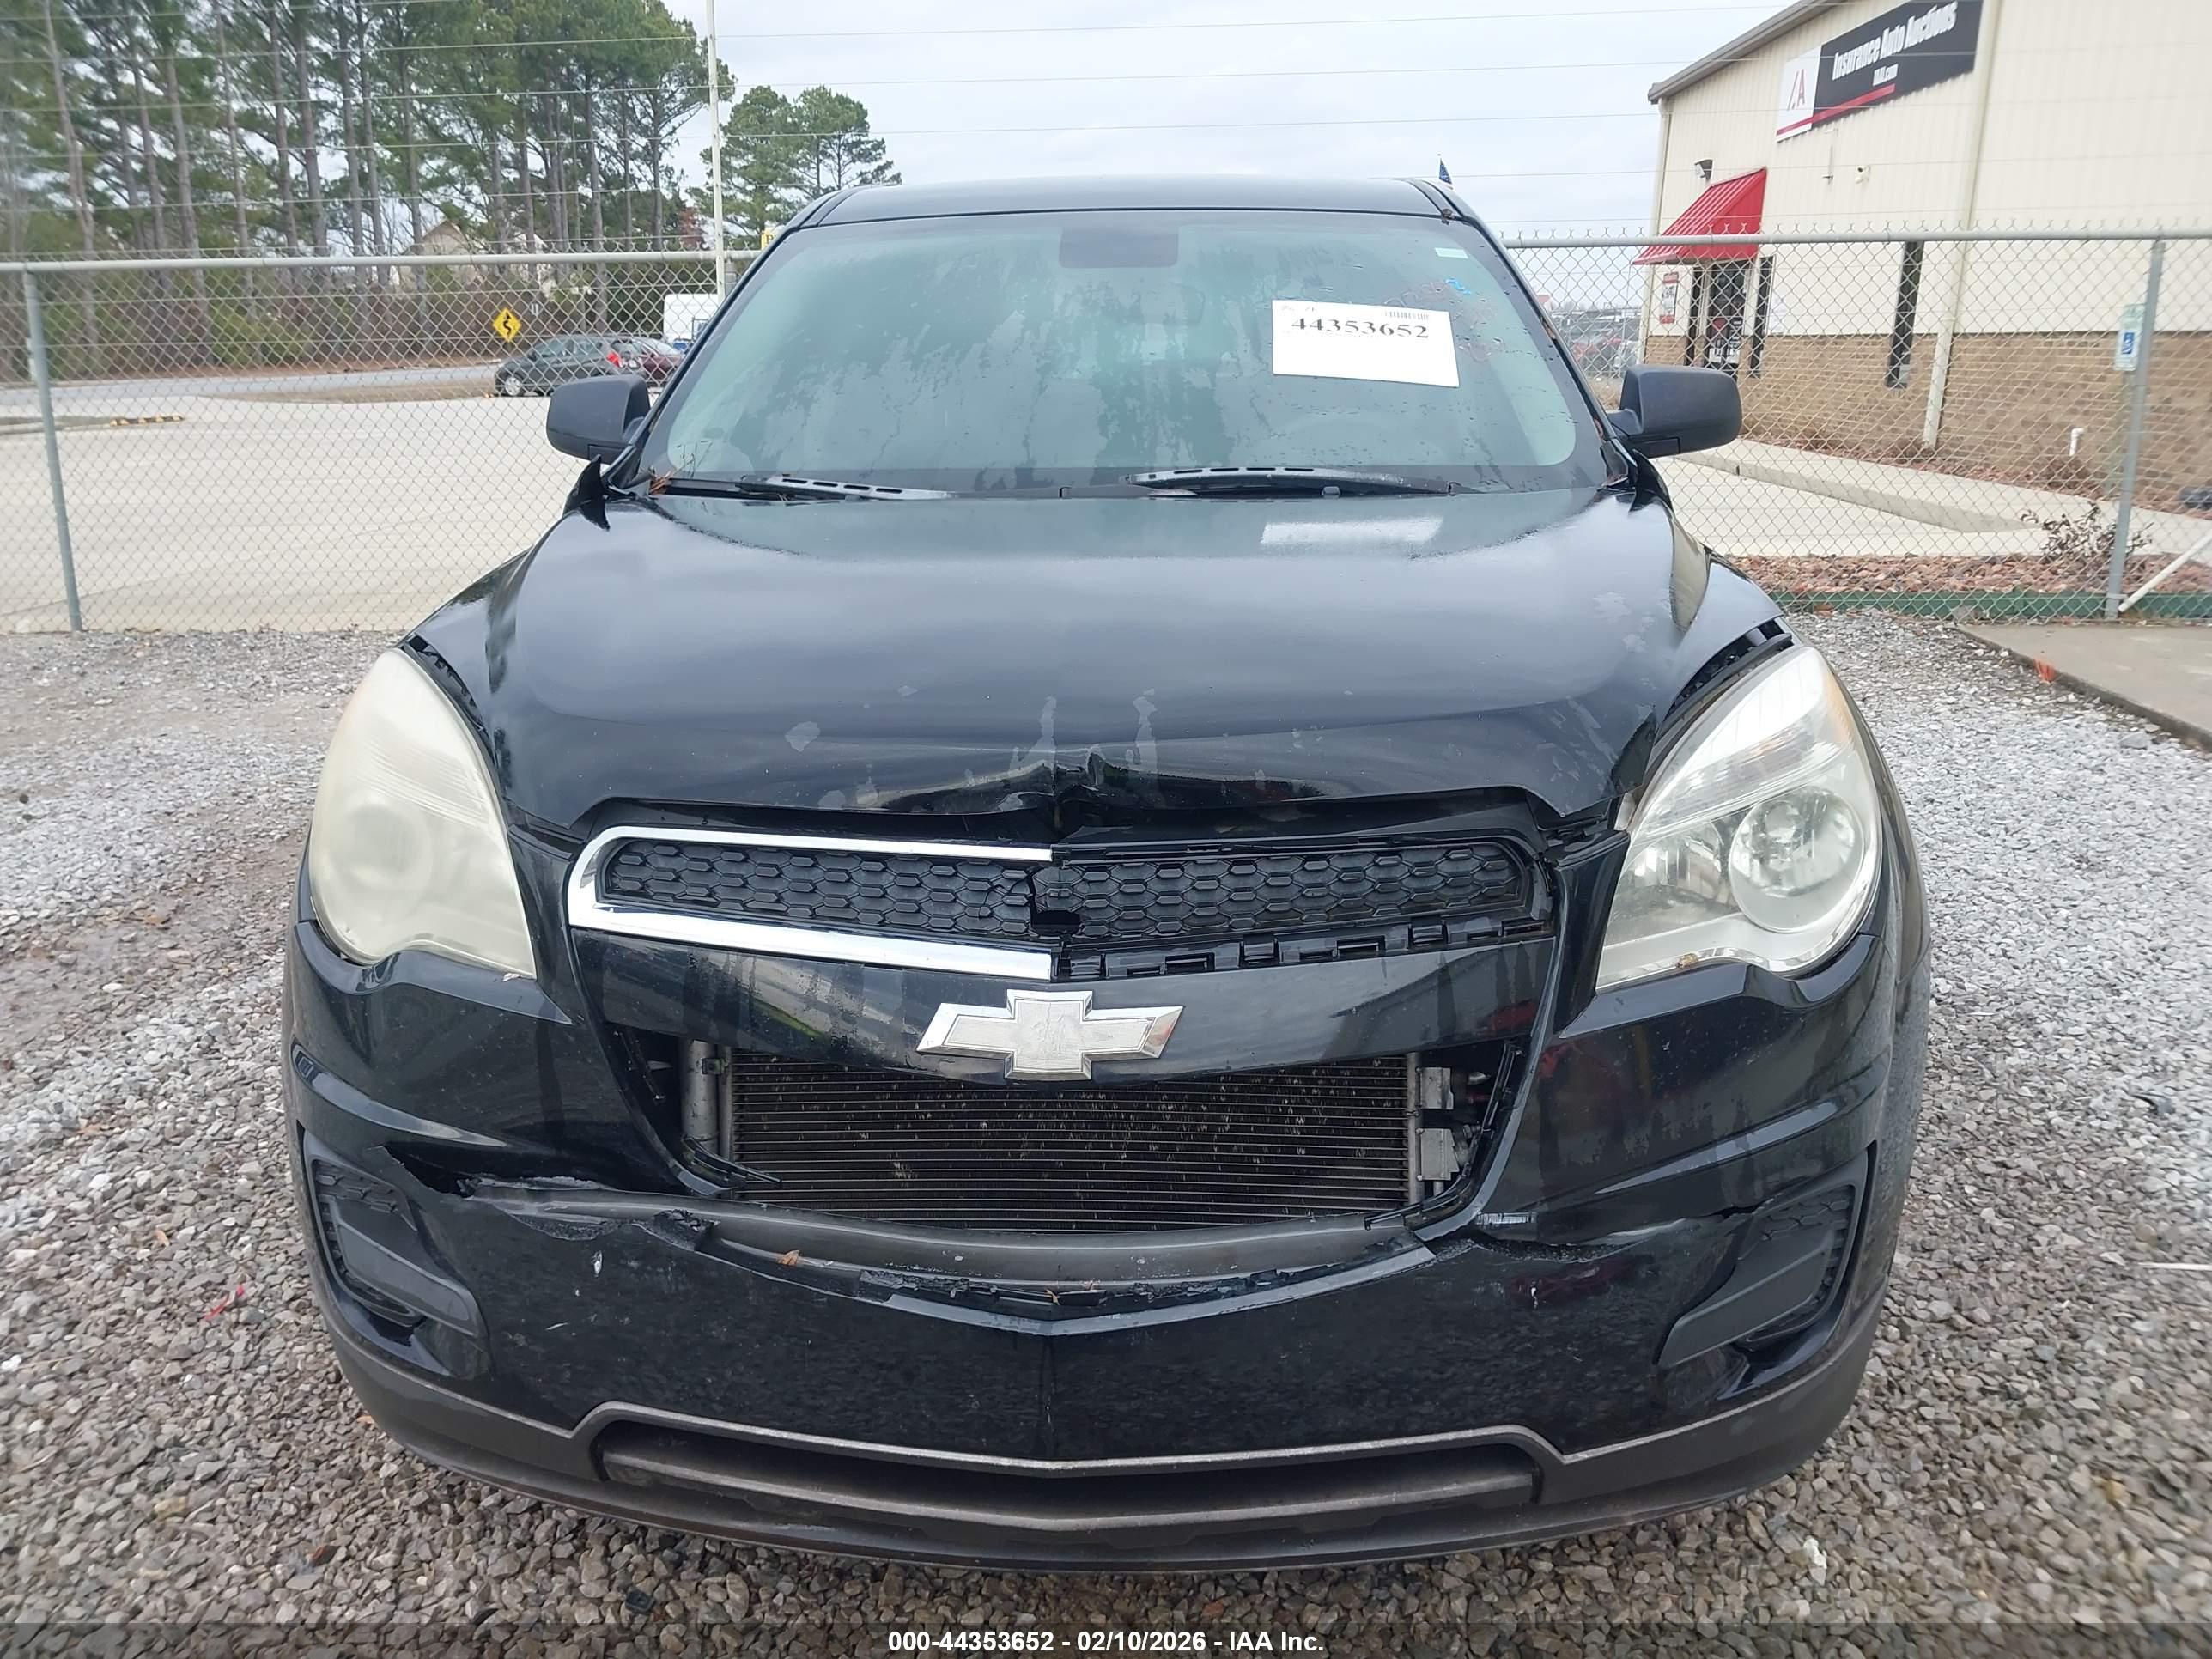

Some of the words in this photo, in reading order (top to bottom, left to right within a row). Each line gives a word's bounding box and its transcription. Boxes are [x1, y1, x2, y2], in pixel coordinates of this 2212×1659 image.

[1832, 37, 1881, 80] Insurance
[1880, 25, 1905, 59] Auto
[1904, 1, 1958, 49] Auctions
[1291, 317, 1430, 338] 44353652
